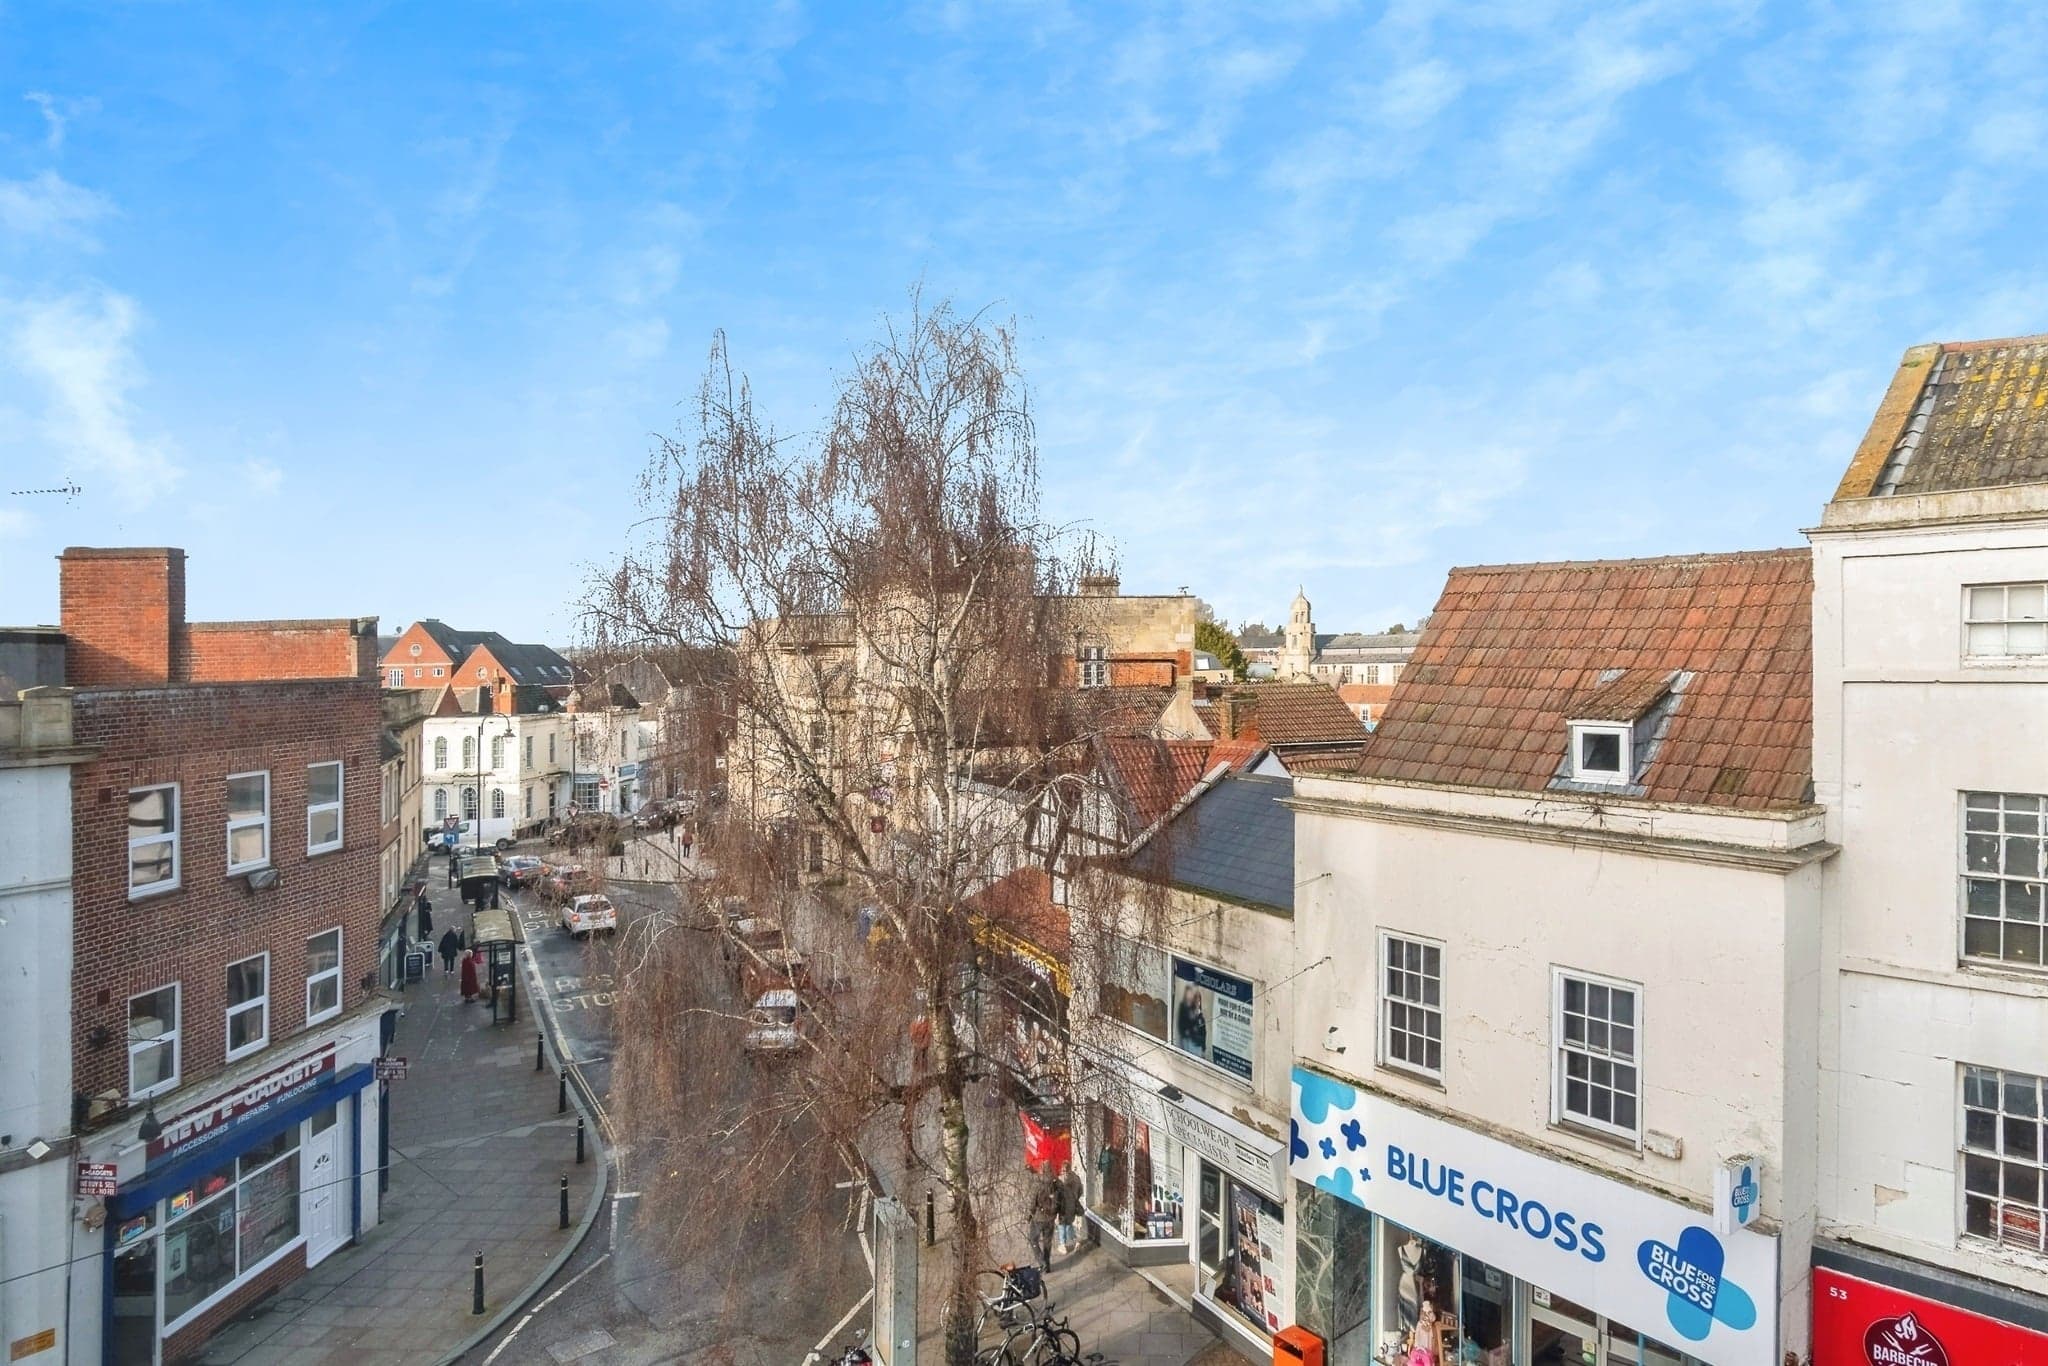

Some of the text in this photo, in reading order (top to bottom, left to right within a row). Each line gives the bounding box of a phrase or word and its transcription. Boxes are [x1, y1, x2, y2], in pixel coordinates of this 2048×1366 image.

[1166, 1105, 1231, 1150] SCHOOLWEAR
[1173, 1125, 1230, 1163] SPECIALISTS
[1734, 1195, 1749, 1206] CROSS
[1735, 1187, 1747, 1197] BLUE
[1388, 1144, 1606, 1263] BLUE CROSS
[1651, 1244, 1696, 1282] BLUE
[1648, 1261, 1713, 1310] CROSS
[1695, 1277, 1717, 1295] PETS
[1697, 1269, 1716, 1286] FOR
[1829, 1286, 1848, 1300] 53
[1873, 1344, 1938, 1366] BARBEC
